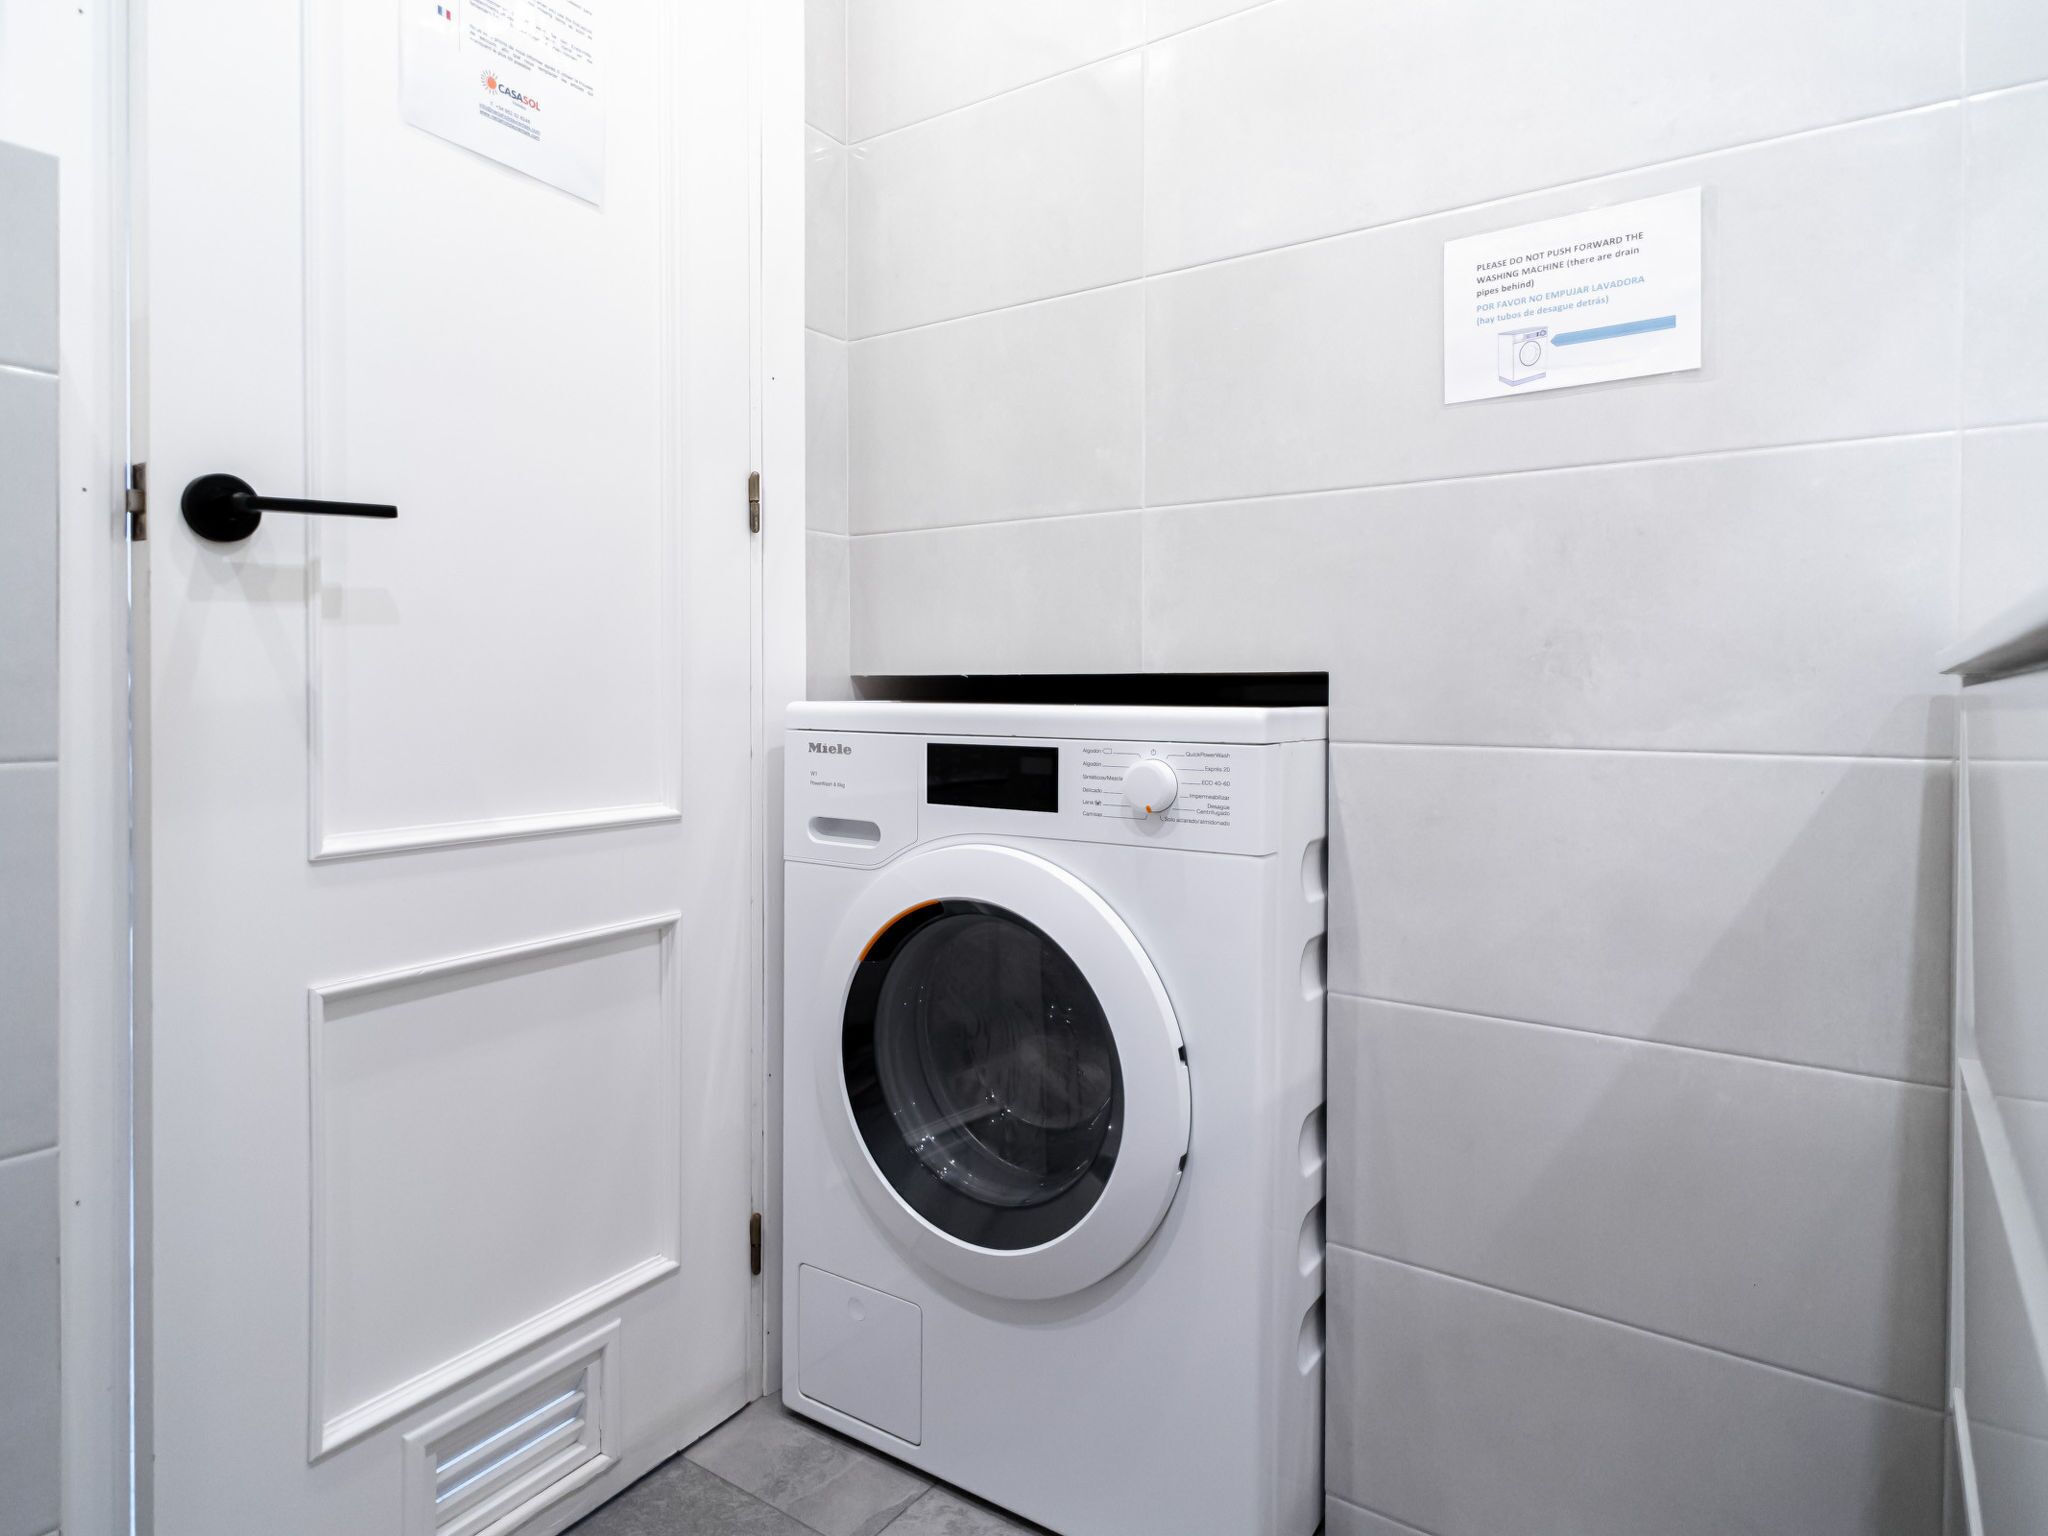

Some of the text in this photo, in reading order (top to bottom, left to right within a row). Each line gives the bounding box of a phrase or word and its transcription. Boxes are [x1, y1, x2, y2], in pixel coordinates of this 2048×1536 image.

[498, 84, 541, 112] CASASOL
[1476, 232, 1644, 272] PLEASE DO NOT PUSH FORWARD THE
[1476, 247, 1640, 284] WASHING MACHINE (there are drain
[1476, 279, 1534, 298] pipes behind)
[1476, 275, 1645, 312] POR FAVOR NO EMPUJAR LAVADORA
[1476, 316, 1495, 326] (hay
[1497, 312, 1521, 321] tubos
[1523, 308, 1534, 317] de
[1576, 295, 1609, 308] detrás)
[808, 742, 852, 755] Miele
[1185, 751, 1230, 759] QuickPowerWash
